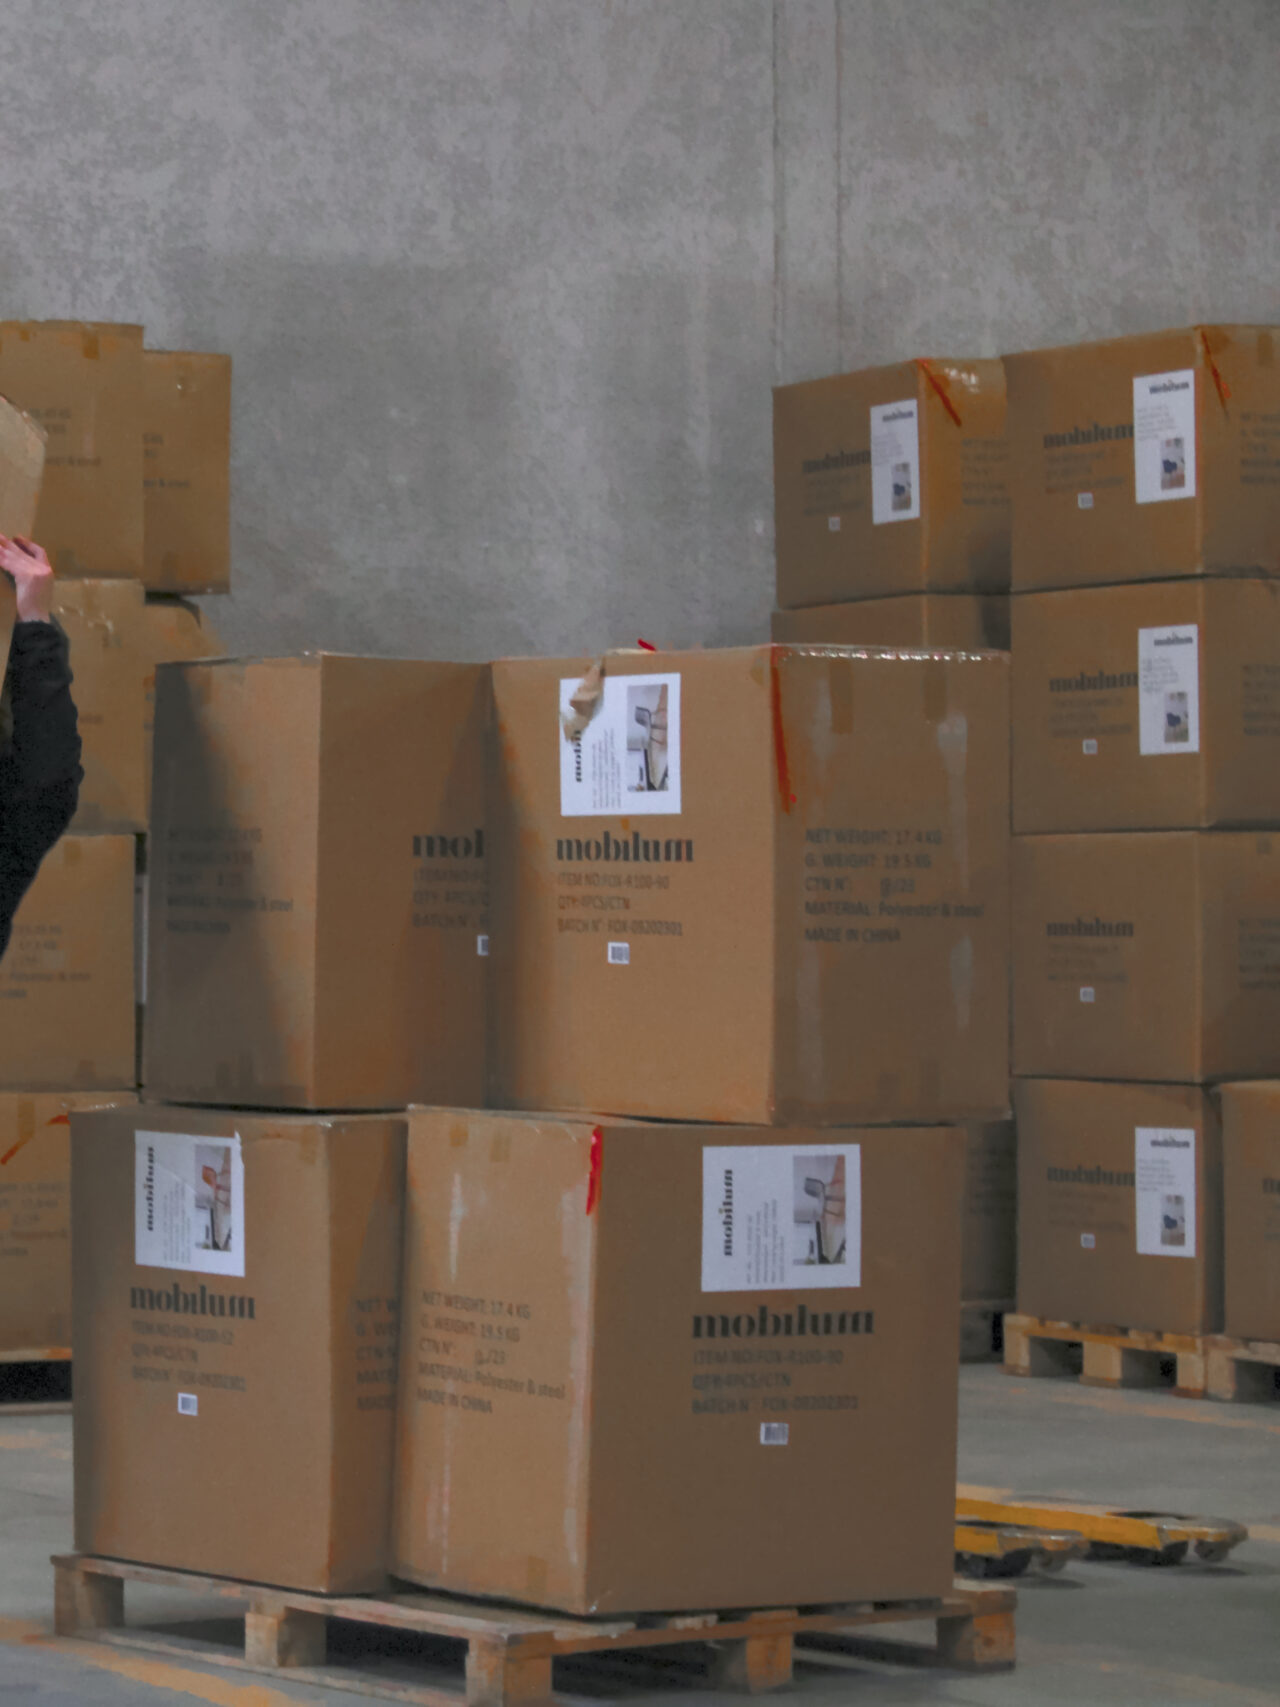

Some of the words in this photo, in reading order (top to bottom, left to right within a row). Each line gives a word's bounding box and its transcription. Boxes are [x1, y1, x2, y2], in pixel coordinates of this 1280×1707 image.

[556, 830, 695, 862] mobilum
[804, 927, 841, 942] MADE
[862, 927, 902, 942] CHINA
[722, 1169, 733, 1257] mobilum
[130, 1282, 256, 1320] mobilum
[692, 1303, 875, 1339] mobilum
[417, 1386, 445, 1407] MADE
[460, 1394, 494, 1415] CHINA
